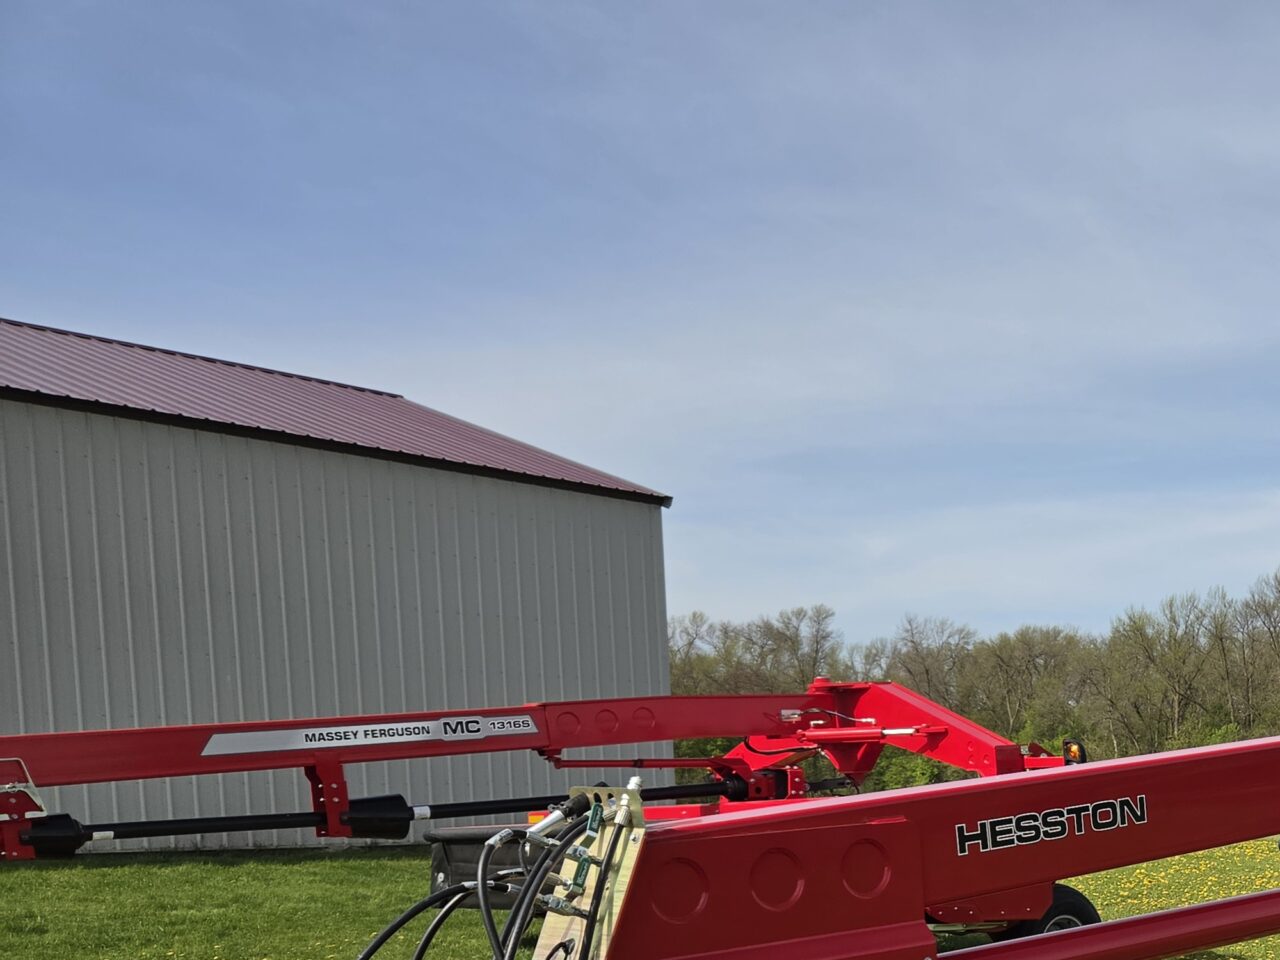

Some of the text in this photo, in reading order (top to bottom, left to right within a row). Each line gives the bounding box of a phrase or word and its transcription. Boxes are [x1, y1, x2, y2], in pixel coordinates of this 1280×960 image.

[304, 720, 531, 743] MASSEY FERGUSON MC 1316S
[955, 795, 1147, 856] HESSTON
